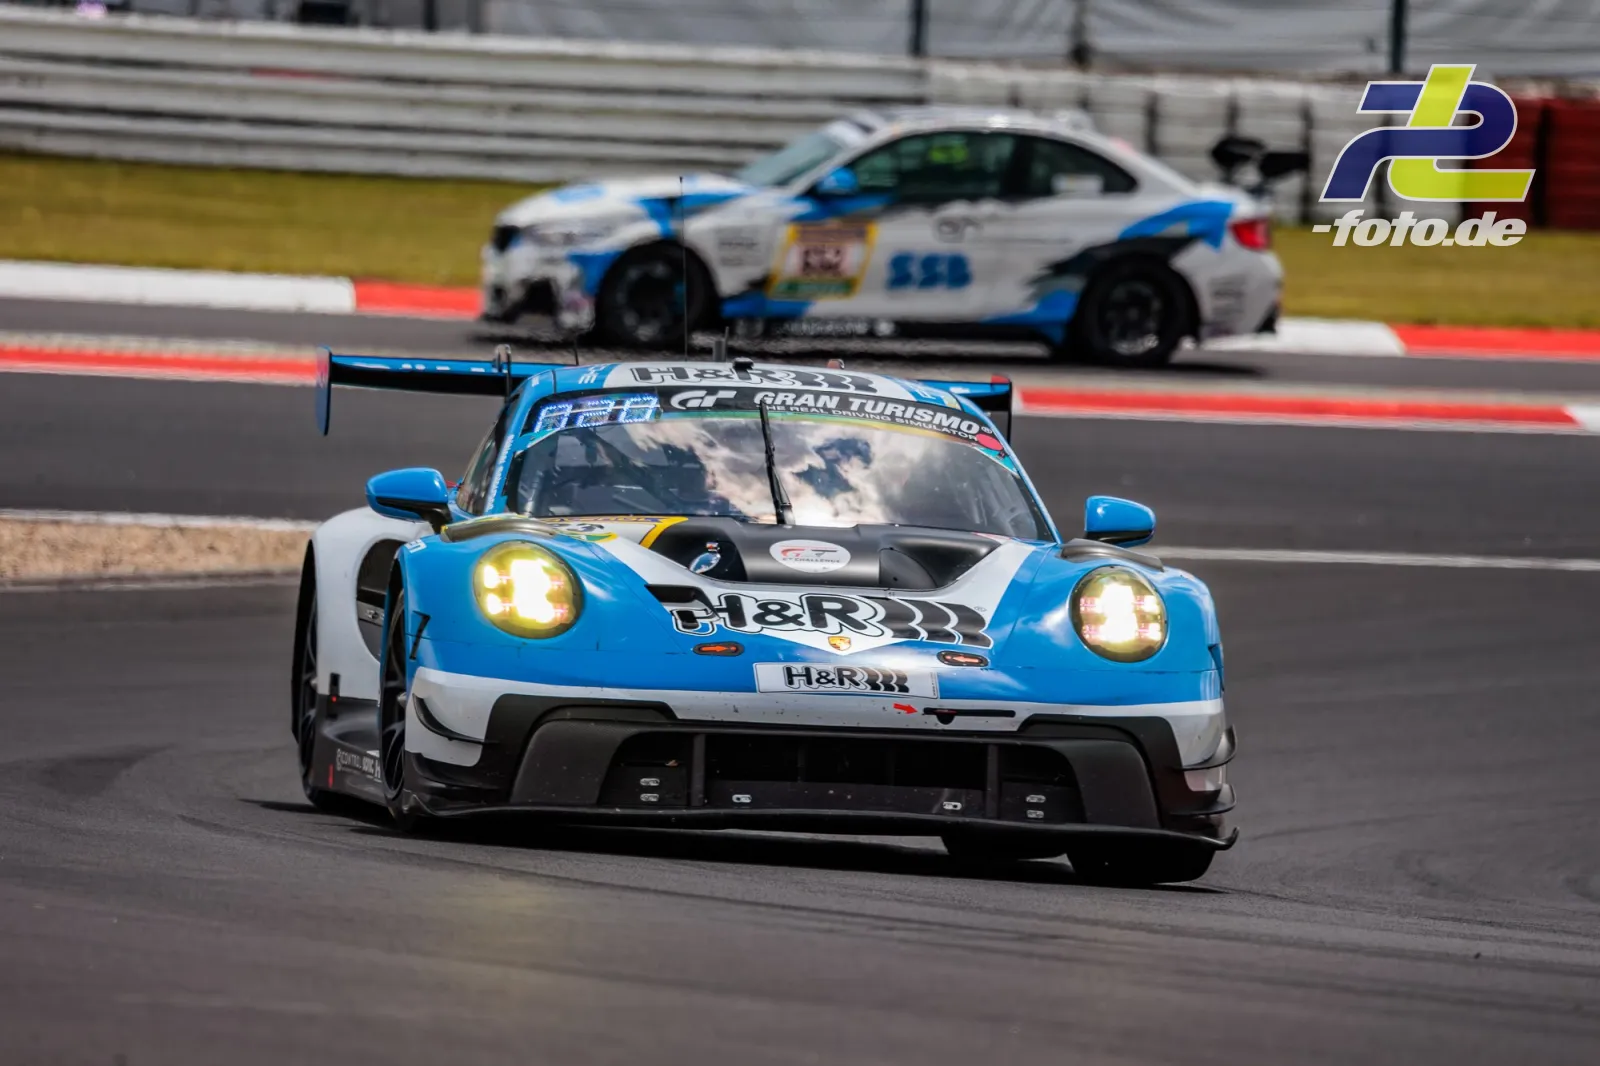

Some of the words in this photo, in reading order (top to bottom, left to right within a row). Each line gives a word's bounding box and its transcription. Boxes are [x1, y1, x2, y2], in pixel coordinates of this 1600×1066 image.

[631, 366, 797, 386] H&R
[753, 391, 840, 409] GRAN
[793, 406, 828, 415] REAL
[832, 409, 892, 421] DRIVING
[896, 417, 978, 441] SIMULATOR
[672, 593, 884, 637] H&R
[783, 664, 868, 691] H&R
